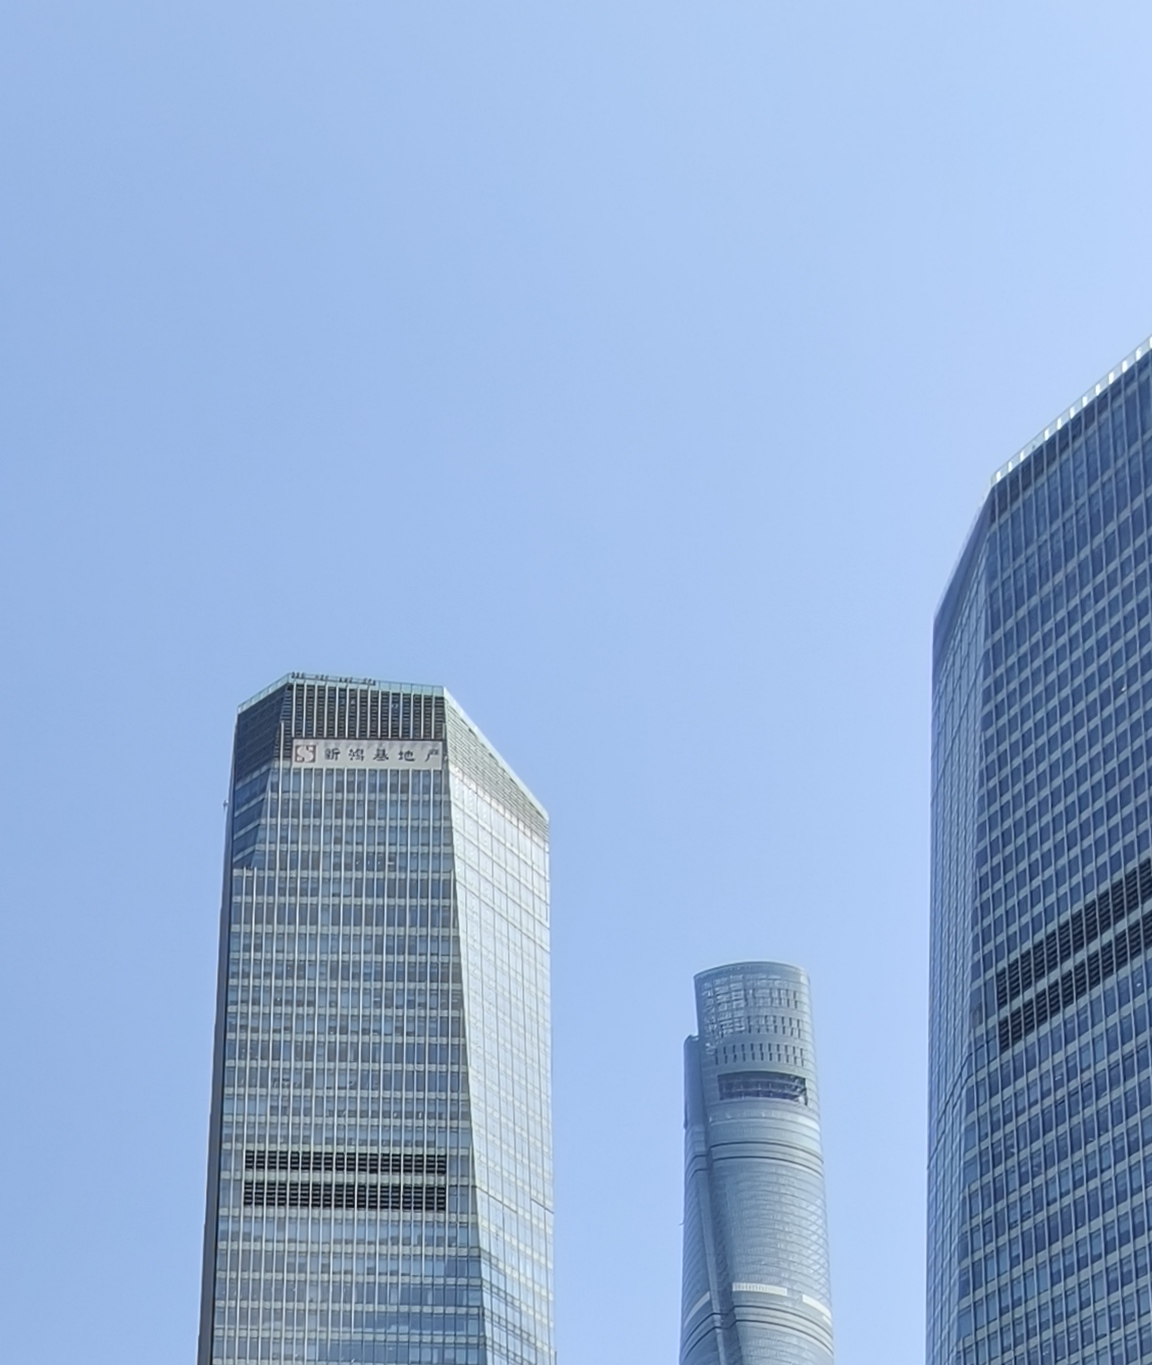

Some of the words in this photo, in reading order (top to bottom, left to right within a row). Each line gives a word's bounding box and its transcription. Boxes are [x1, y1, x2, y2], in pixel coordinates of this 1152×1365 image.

[323, 747, 440, 762] 新鸿基地产
